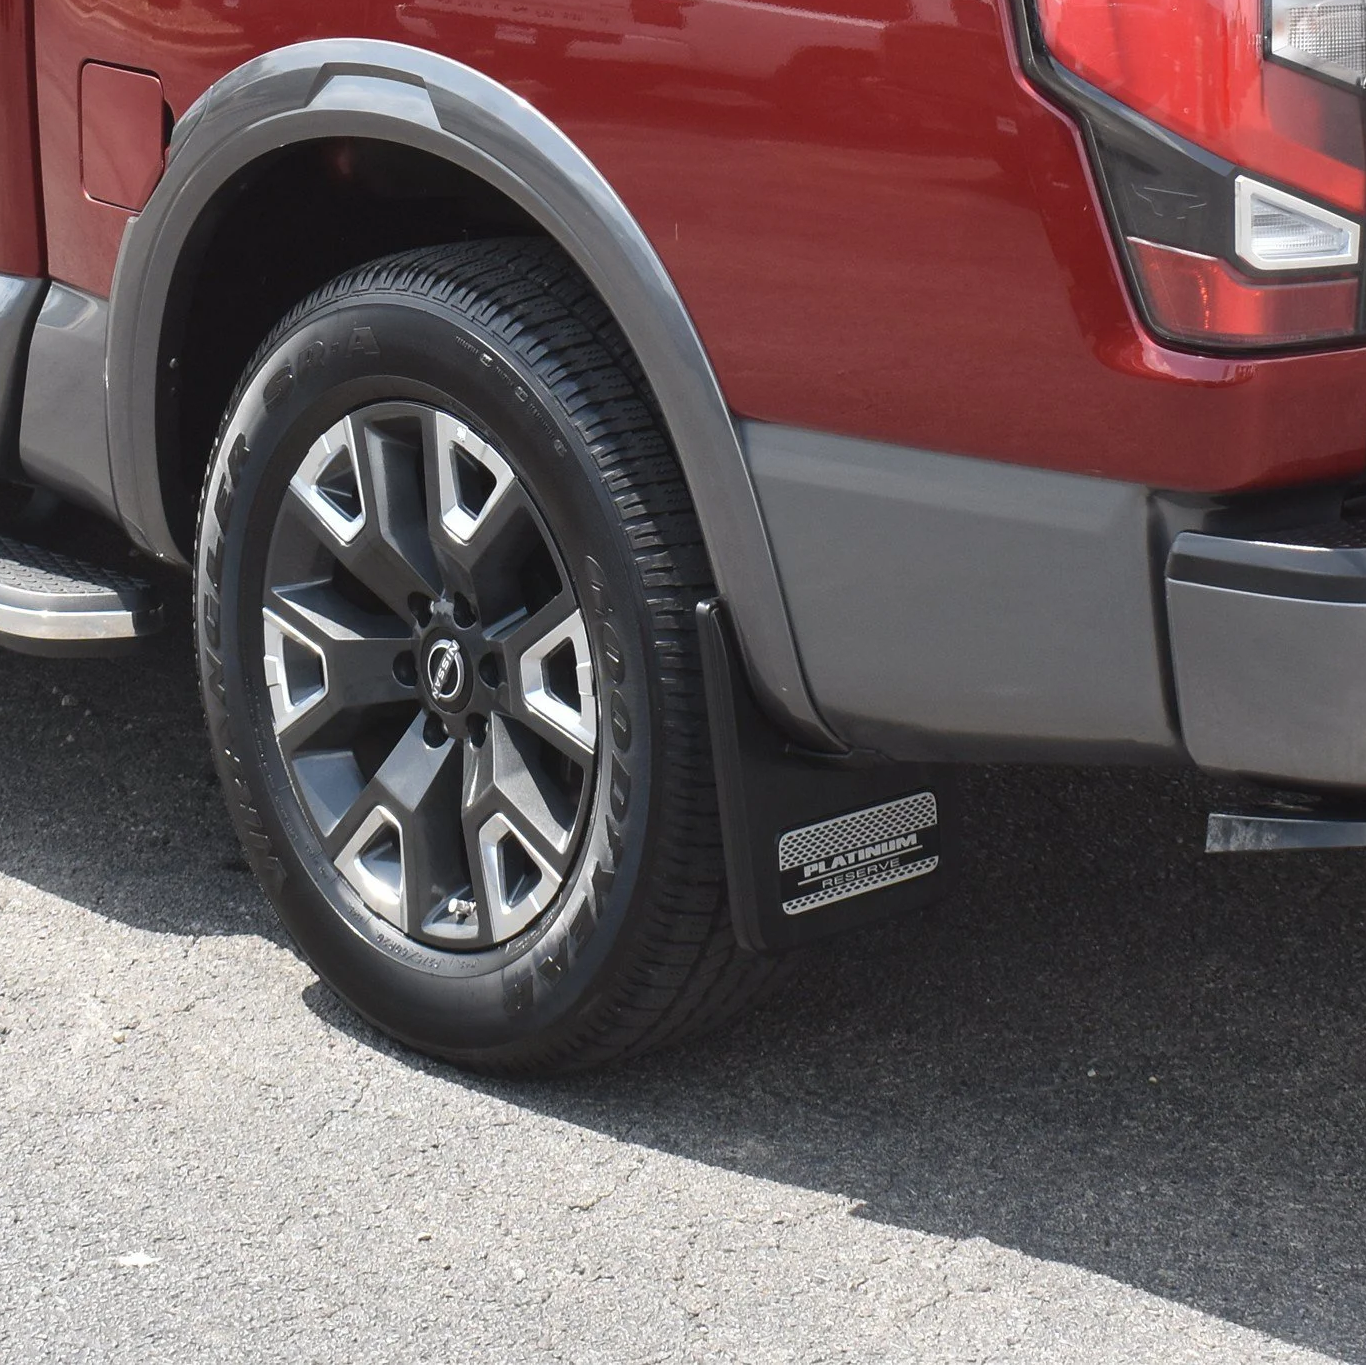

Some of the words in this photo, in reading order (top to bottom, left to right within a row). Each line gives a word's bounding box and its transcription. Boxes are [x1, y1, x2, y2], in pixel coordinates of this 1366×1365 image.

[432, 640, 459, 701] NISSAN
[502, 554, 633, 1015] GOODYEAR
[803, 833, 918, 878] PLATINUM
[822, 858, 901, 888] RESERVE
